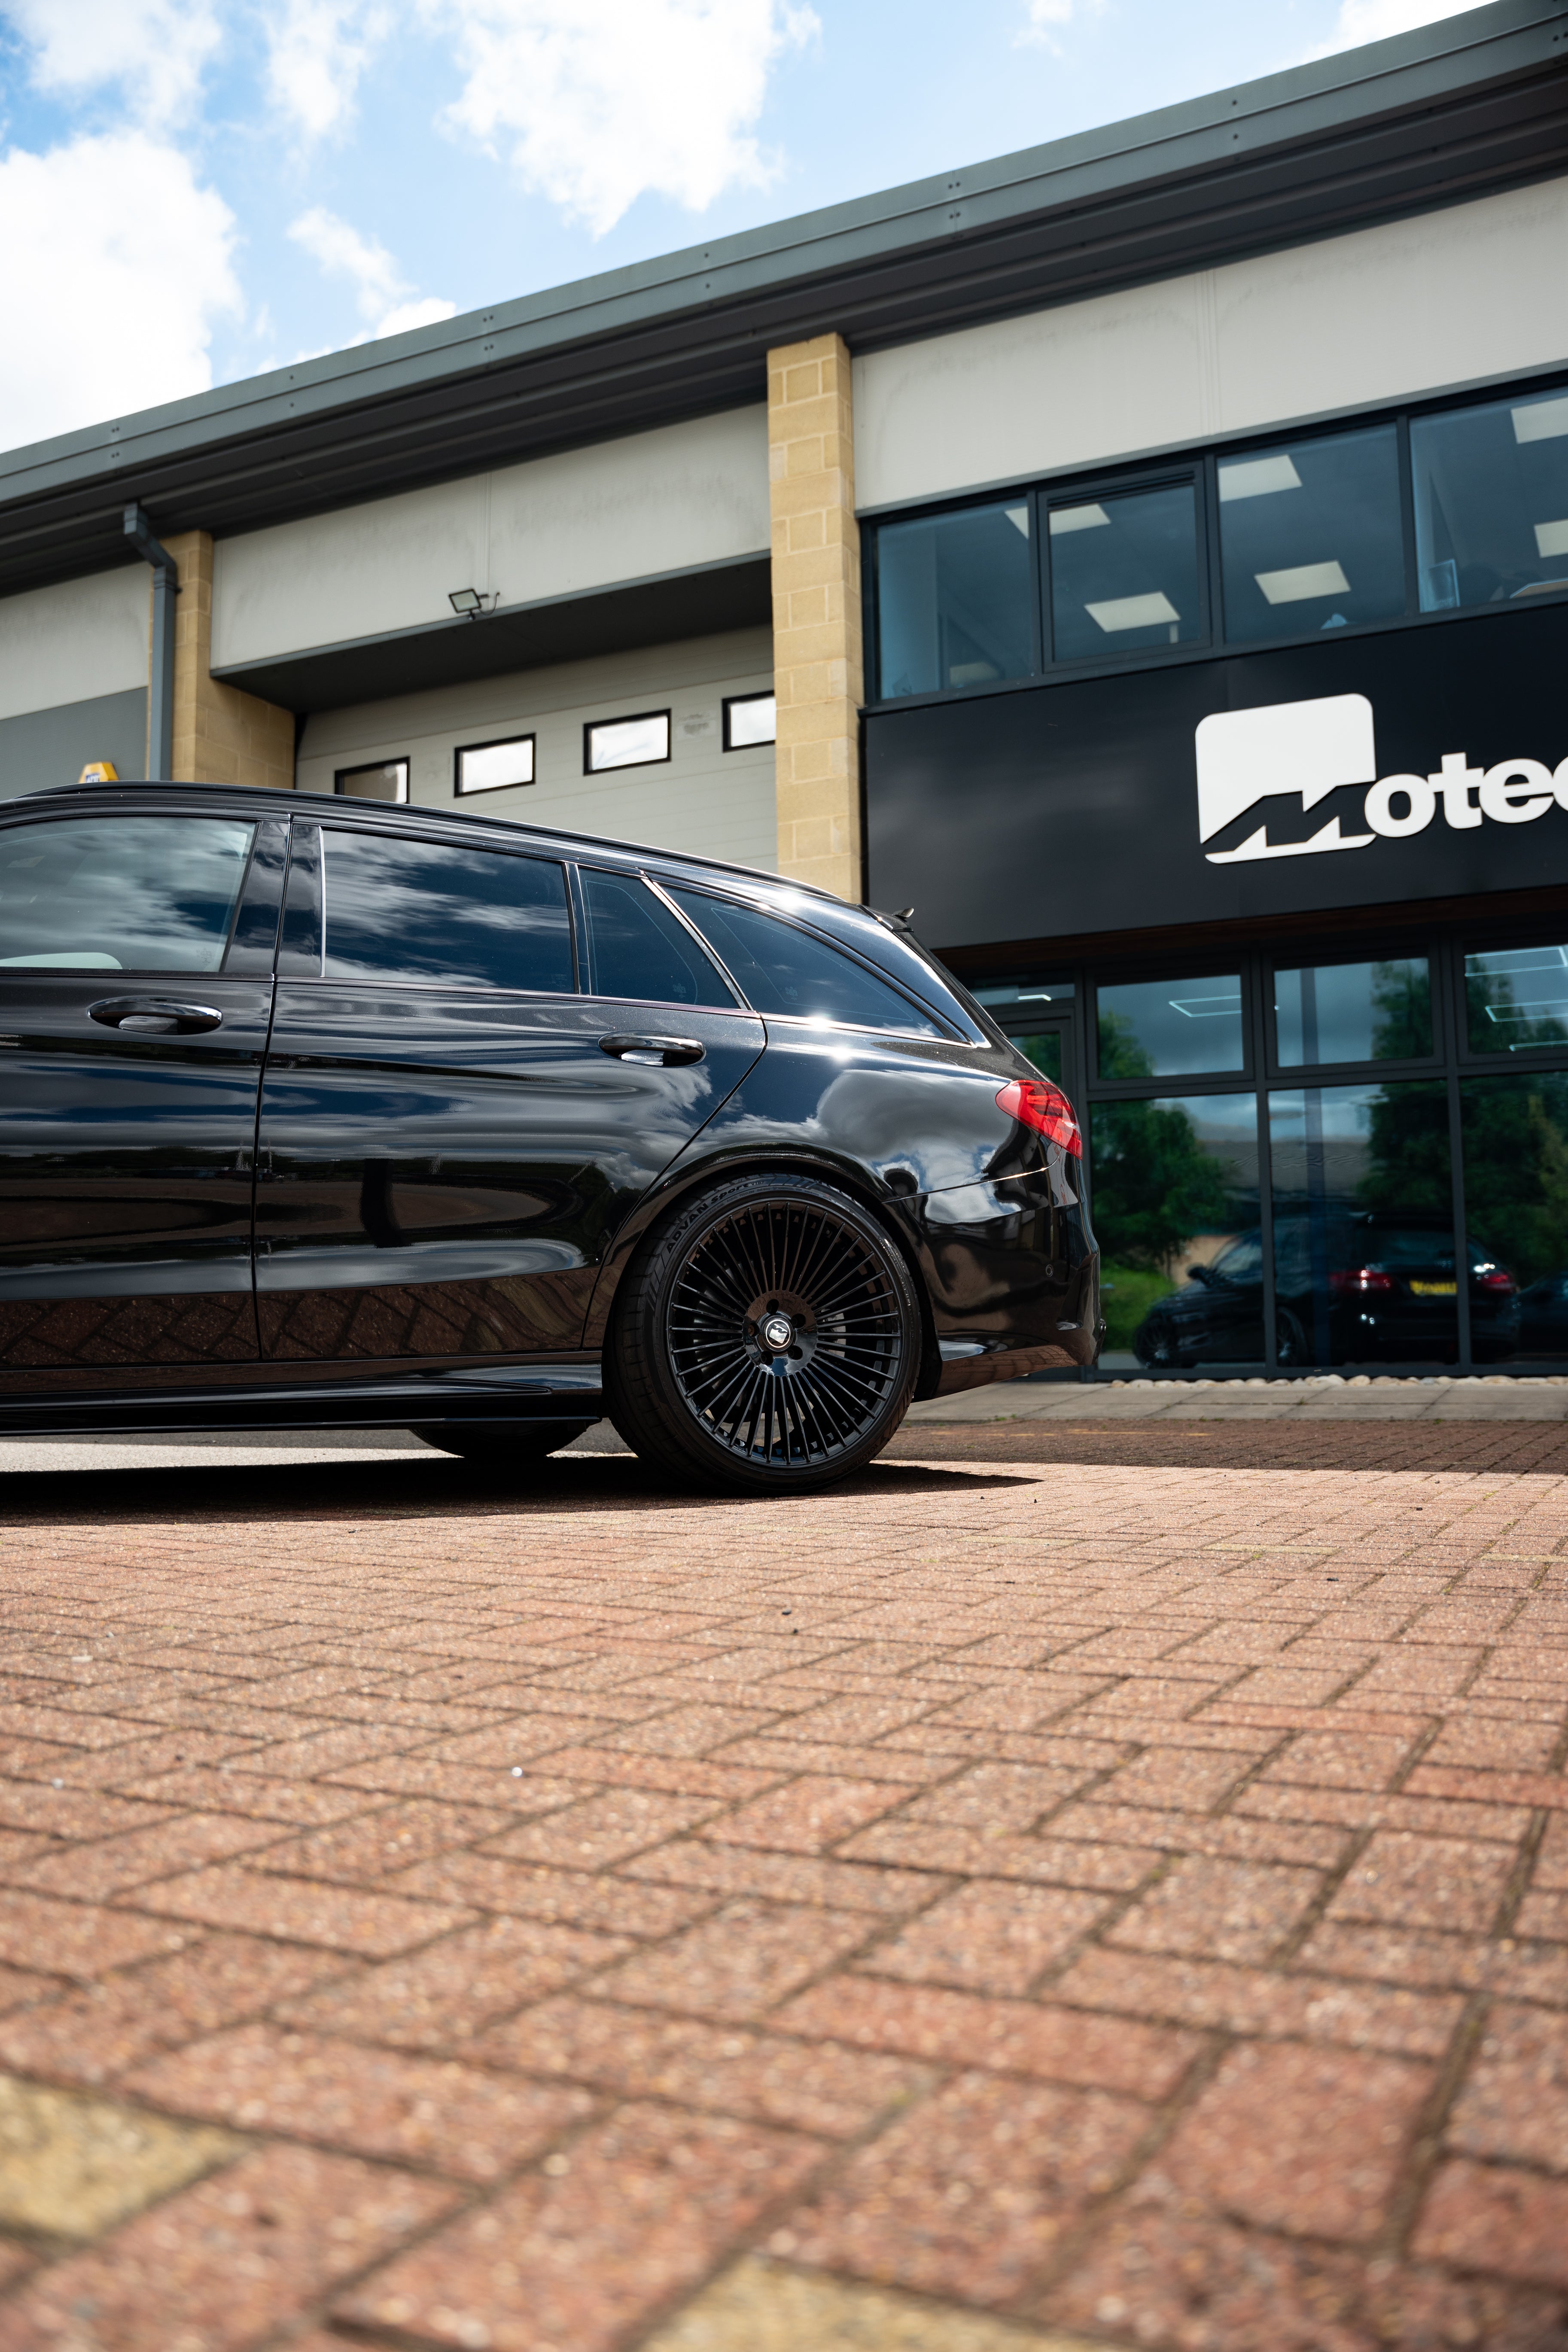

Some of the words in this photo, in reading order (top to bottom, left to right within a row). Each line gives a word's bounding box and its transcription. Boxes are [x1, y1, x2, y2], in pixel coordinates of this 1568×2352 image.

[1201, 752, 1568, 864] Mote
[667, 1203, 709, 1254] ADVAN
[711, 1183, 749, 1203] Sport
[842, 1444, 879, 1474] YOKOHAMA
